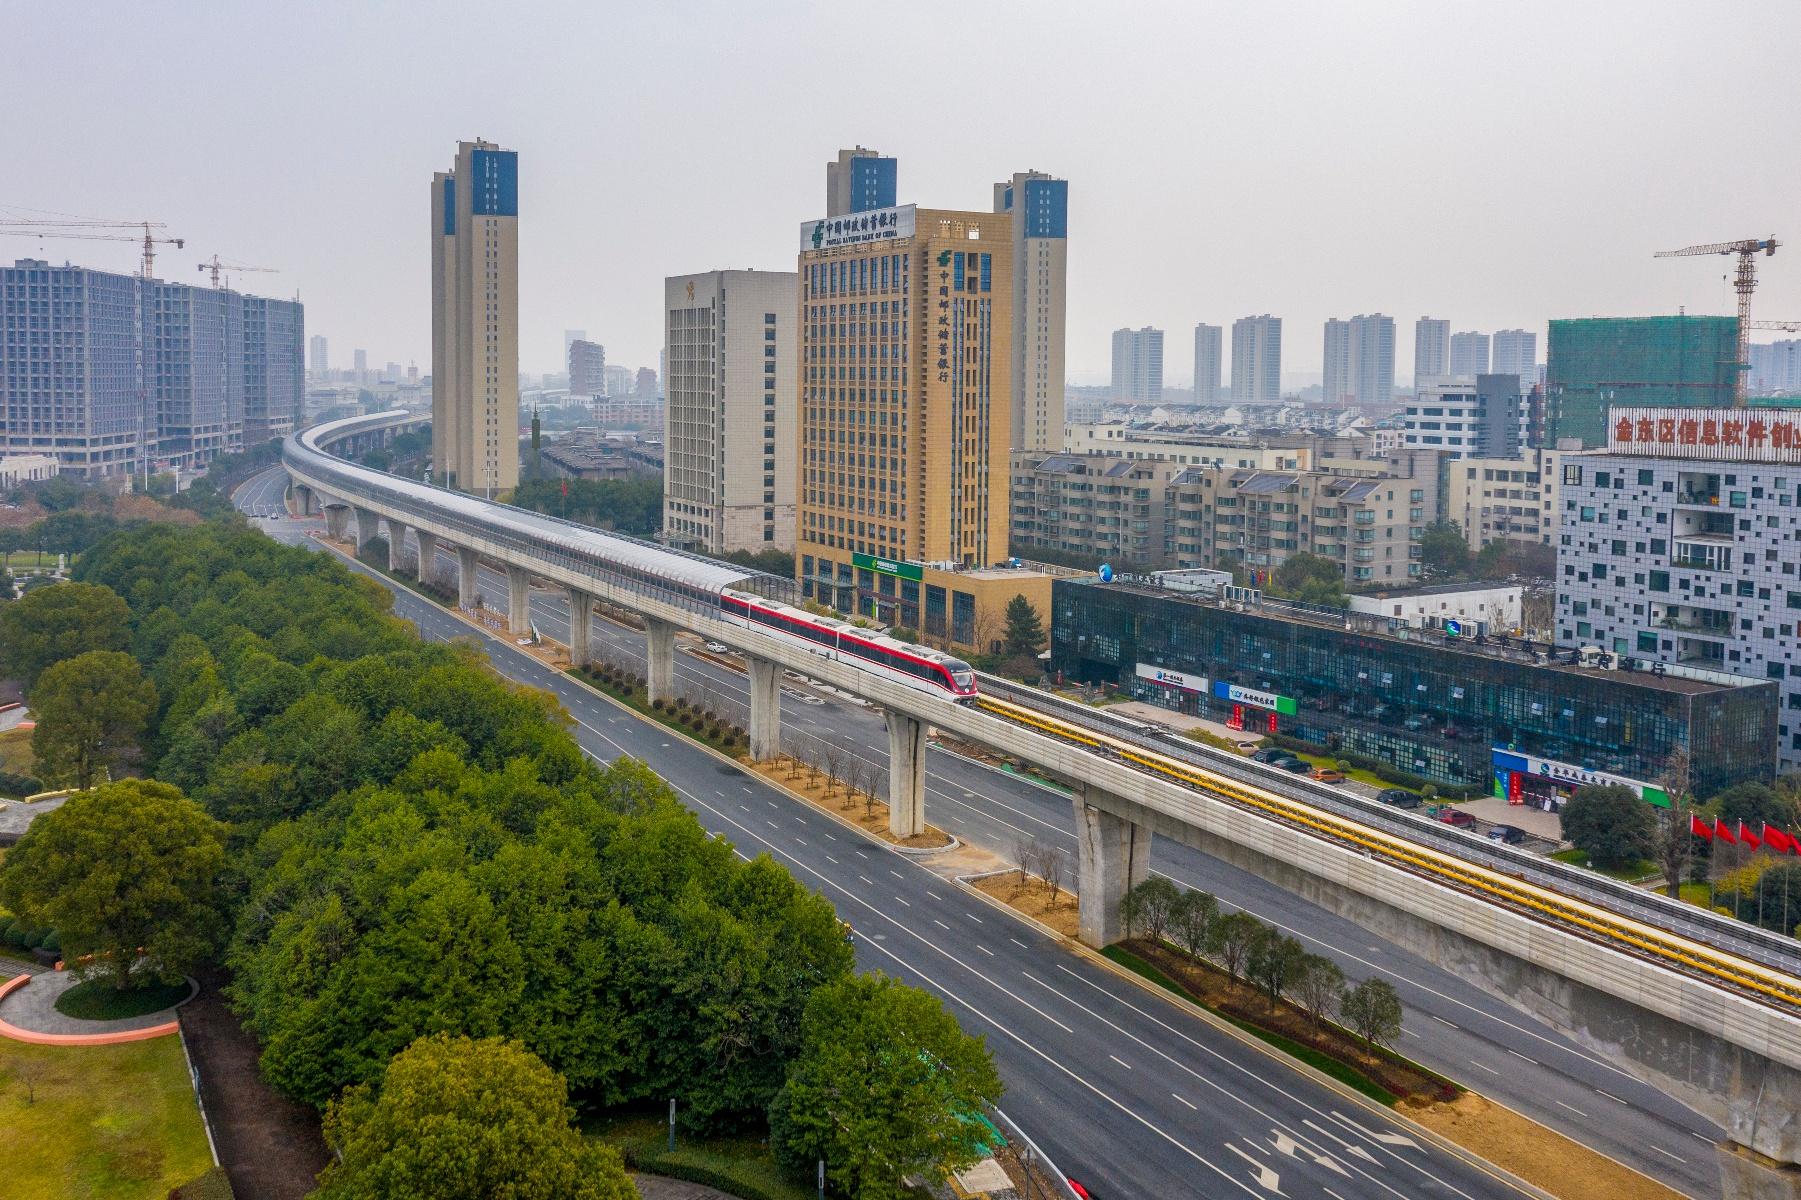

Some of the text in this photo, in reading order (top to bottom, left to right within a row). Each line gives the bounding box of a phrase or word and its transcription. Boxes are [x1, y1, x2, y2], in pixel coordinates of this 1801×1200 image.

[826, 212, 897, 238] 中国邮政储蓄银行
[826, 237, 842, 246] POSTAL
[843, 235, 861, 243] SAVINGS
[862, 233, 874, 241] BANK
[883, 230, 897, 238] CHINA
[938, 270, 950, 382] 中国邮政储蓄银行
